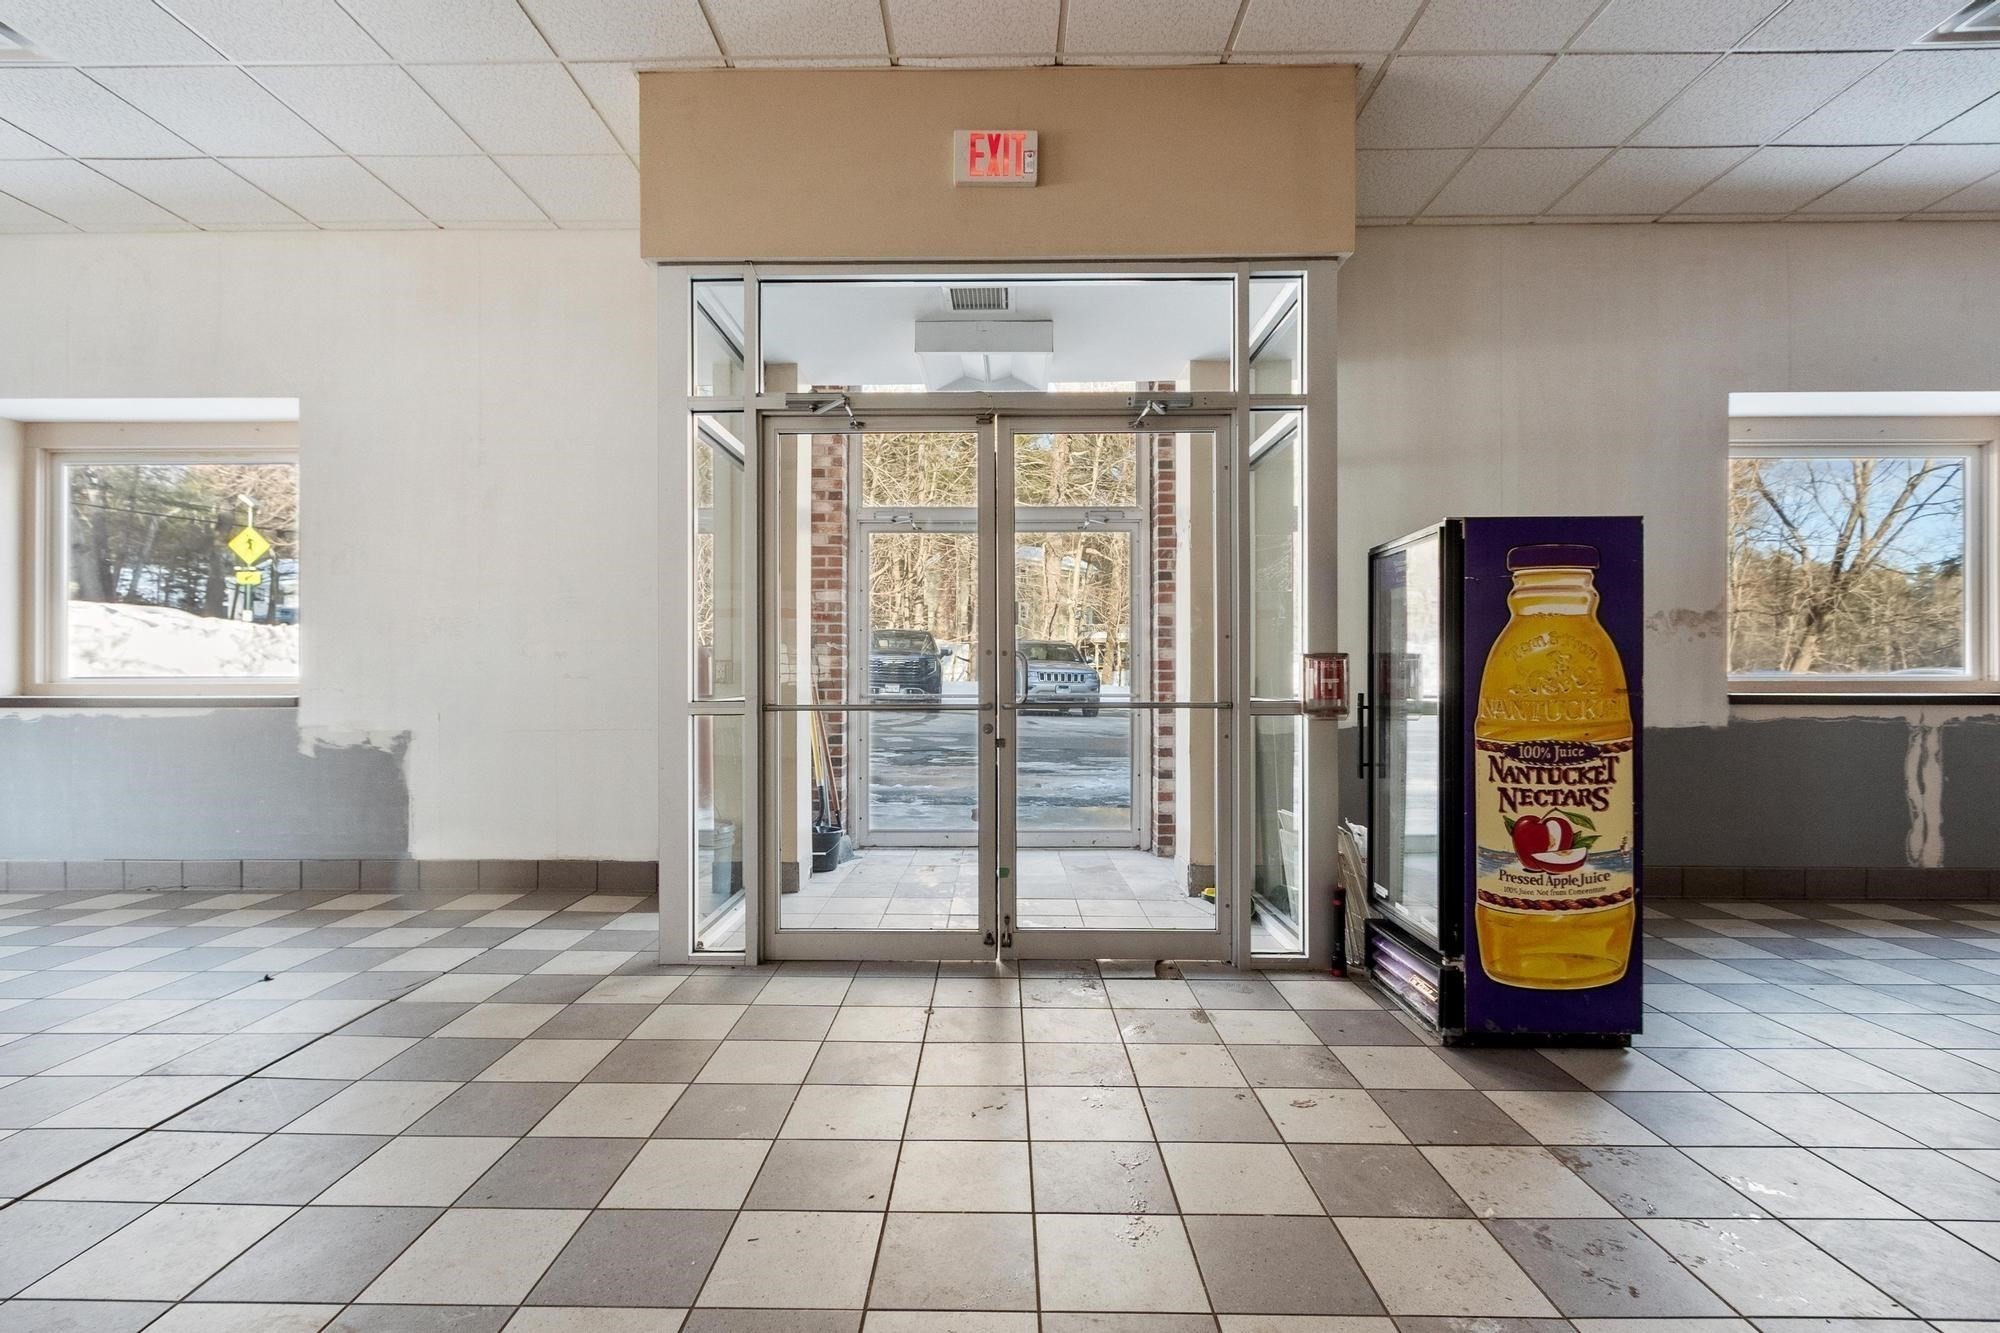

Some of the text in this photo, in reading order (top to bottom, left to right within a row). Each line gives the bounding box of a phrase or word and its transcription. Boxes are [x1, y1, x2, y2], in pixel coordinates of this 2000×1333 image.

[969, 133, 1027, 177] EXIT
[1518, 745, 1585, 762] 100% Juice
[1488, 755, 1620, 785] NANTUCKET
[1497, 786, 1610, 814] NECTARS
[1498, 869, 1611, 889] Pressed Apple Juice
[1550, 888, 1567, 896] from
